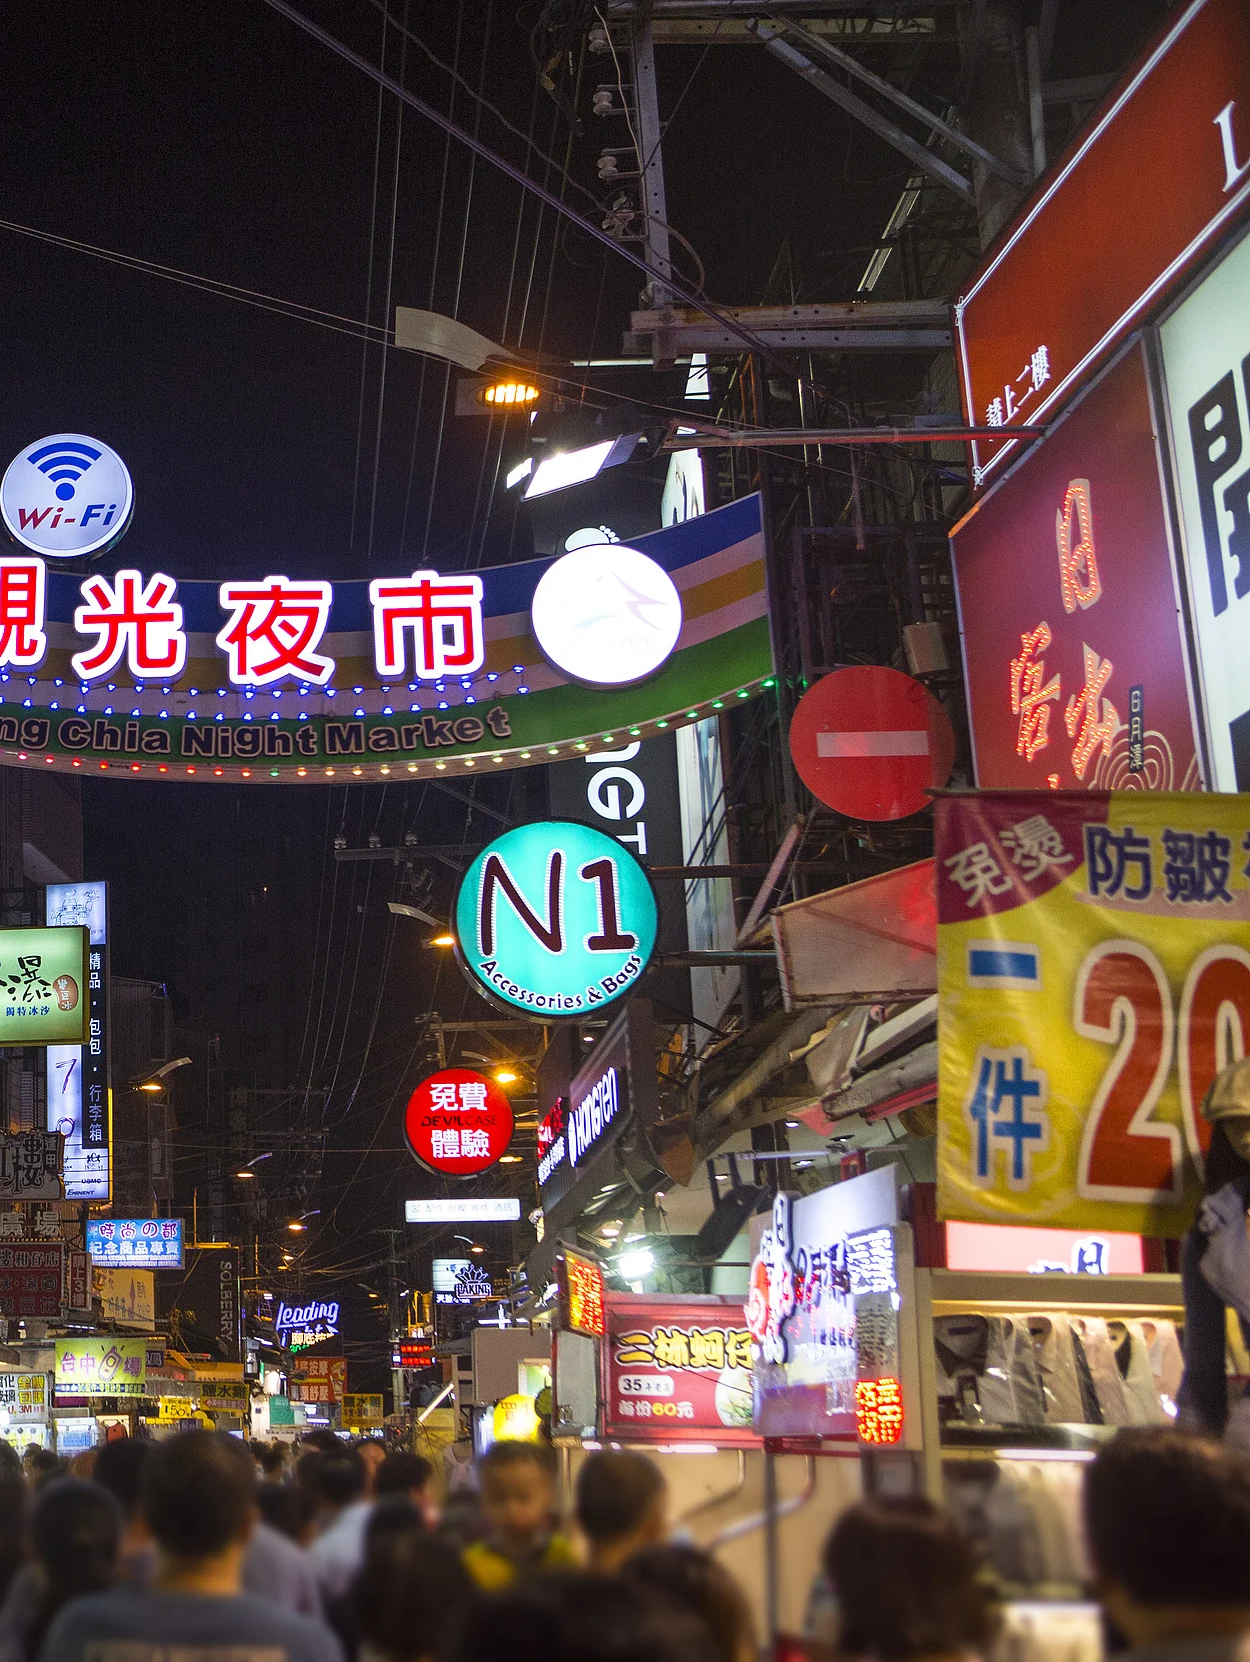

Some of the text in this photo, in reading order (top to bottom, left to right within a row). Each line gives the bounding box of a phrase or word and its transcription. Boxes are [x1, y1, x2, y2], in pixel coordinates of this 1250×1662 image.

[18, 502, 116, 531] Wi-Fi
[52, 718, 169, 755] Chia
[182, 724, 317, 758] Night
[325, 705, 510, 754] Market
[945, 815, 1073, 907] 免燙
[479, 850, 637, 956] N1
[480, 960, 582, 1009] Accessories
[601, 955, 642, 994] Bags
[967, 945, 1045, 1186] 一件
[429, 1082, 488, 1111] 免費
[431, 1129, 490, 1158] 體驗
[219, 1260, 233, 1342] SOLBERRY
[276, 1301, 339, 1331] Leading
[61, 1352, 95, 1375] 台中
